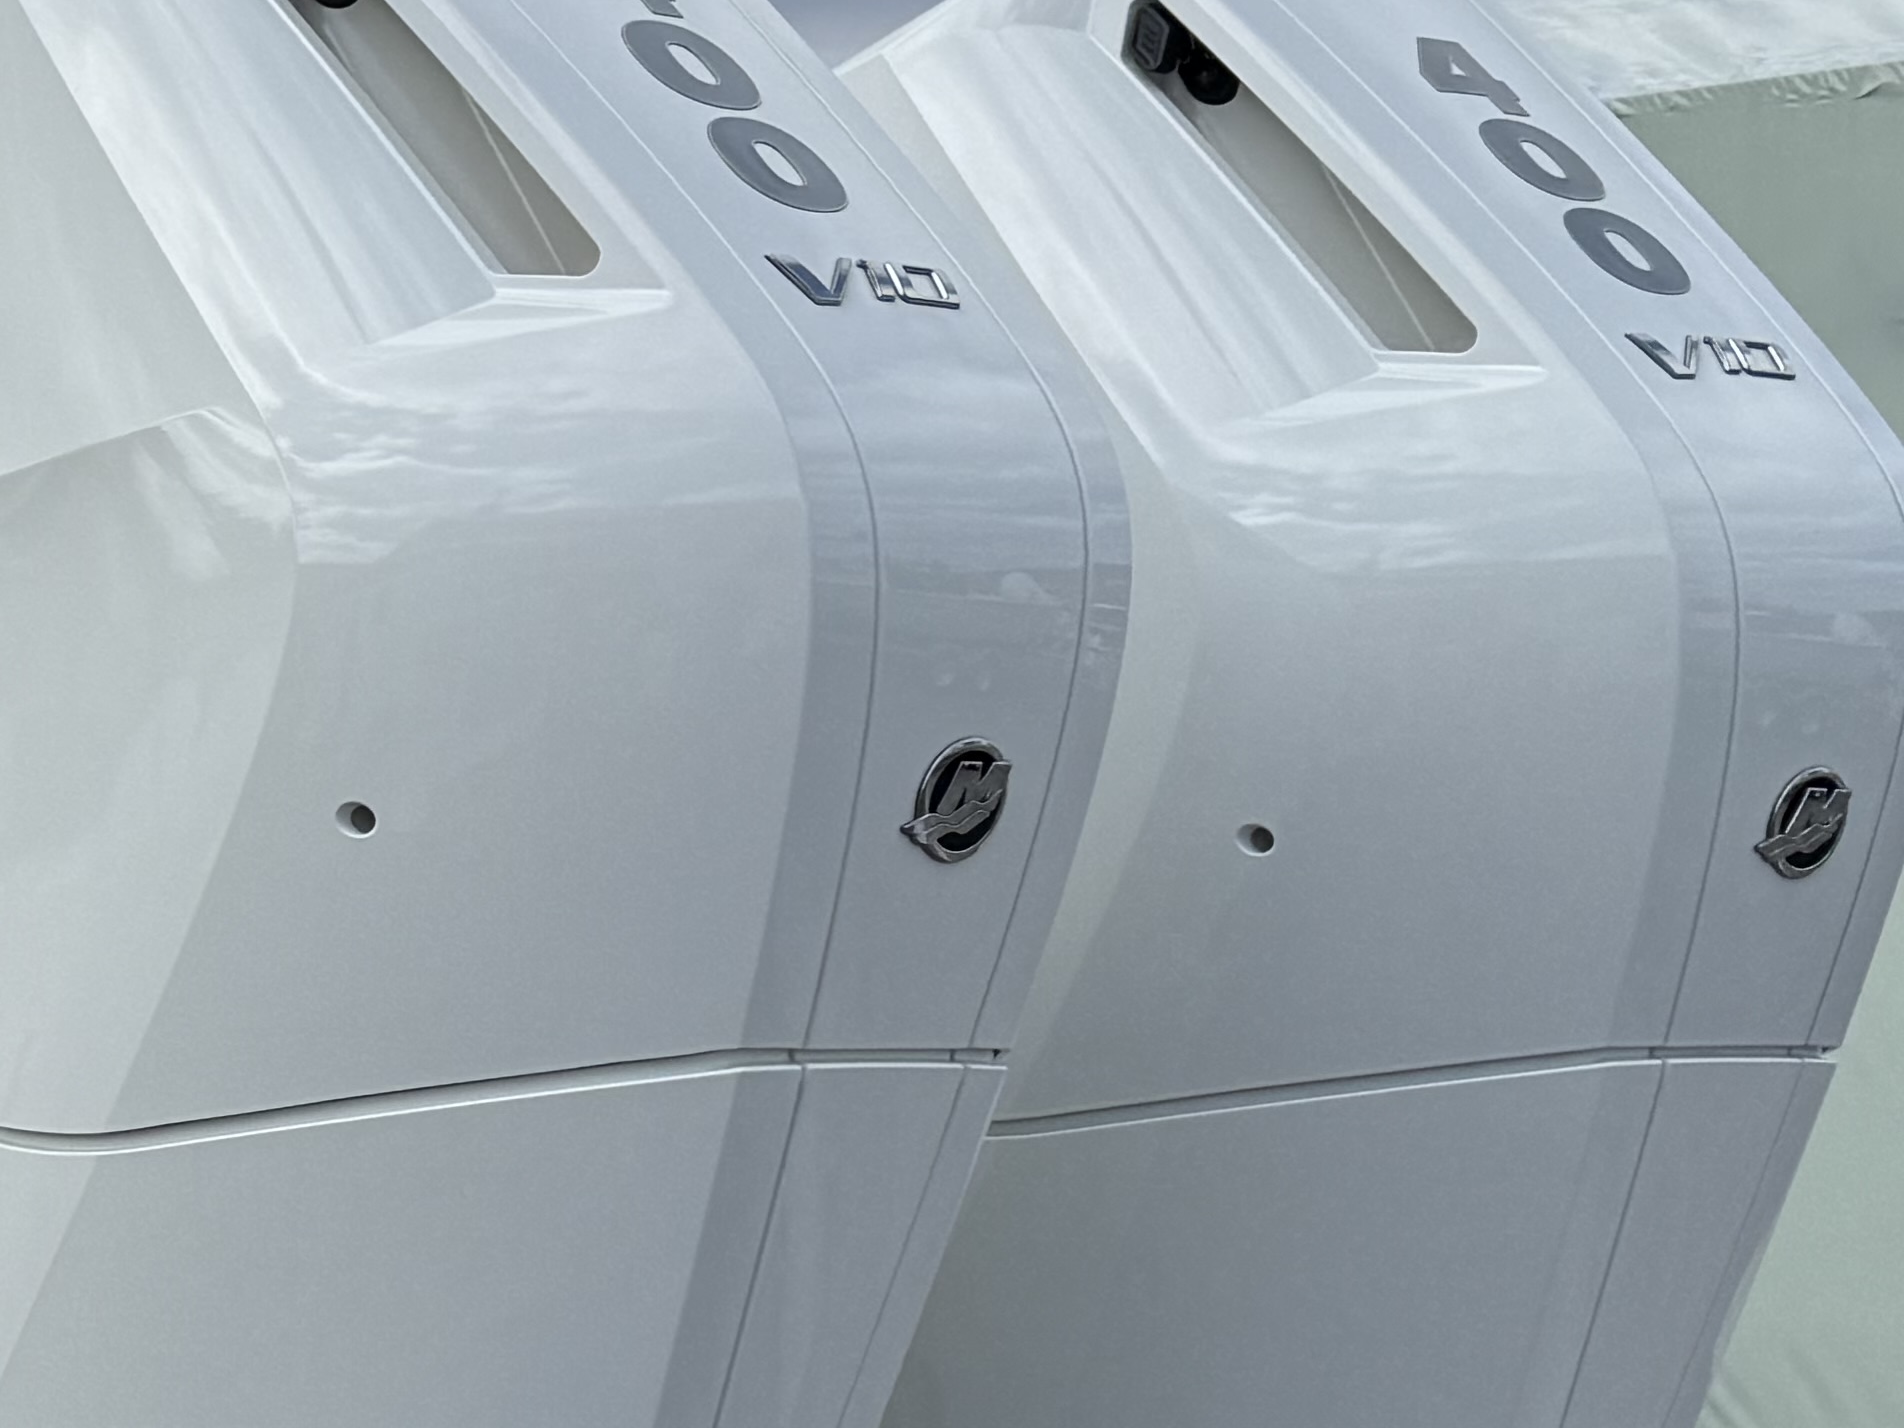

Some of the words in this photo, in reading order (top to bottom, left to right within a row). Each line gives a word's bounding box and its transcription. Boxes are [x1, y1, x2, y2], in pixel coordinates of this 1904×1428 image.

[1416, 36, 1691, 295] 400
[764, 253, 961, 309] V10
[1624, 332, 1797, 380] V10
